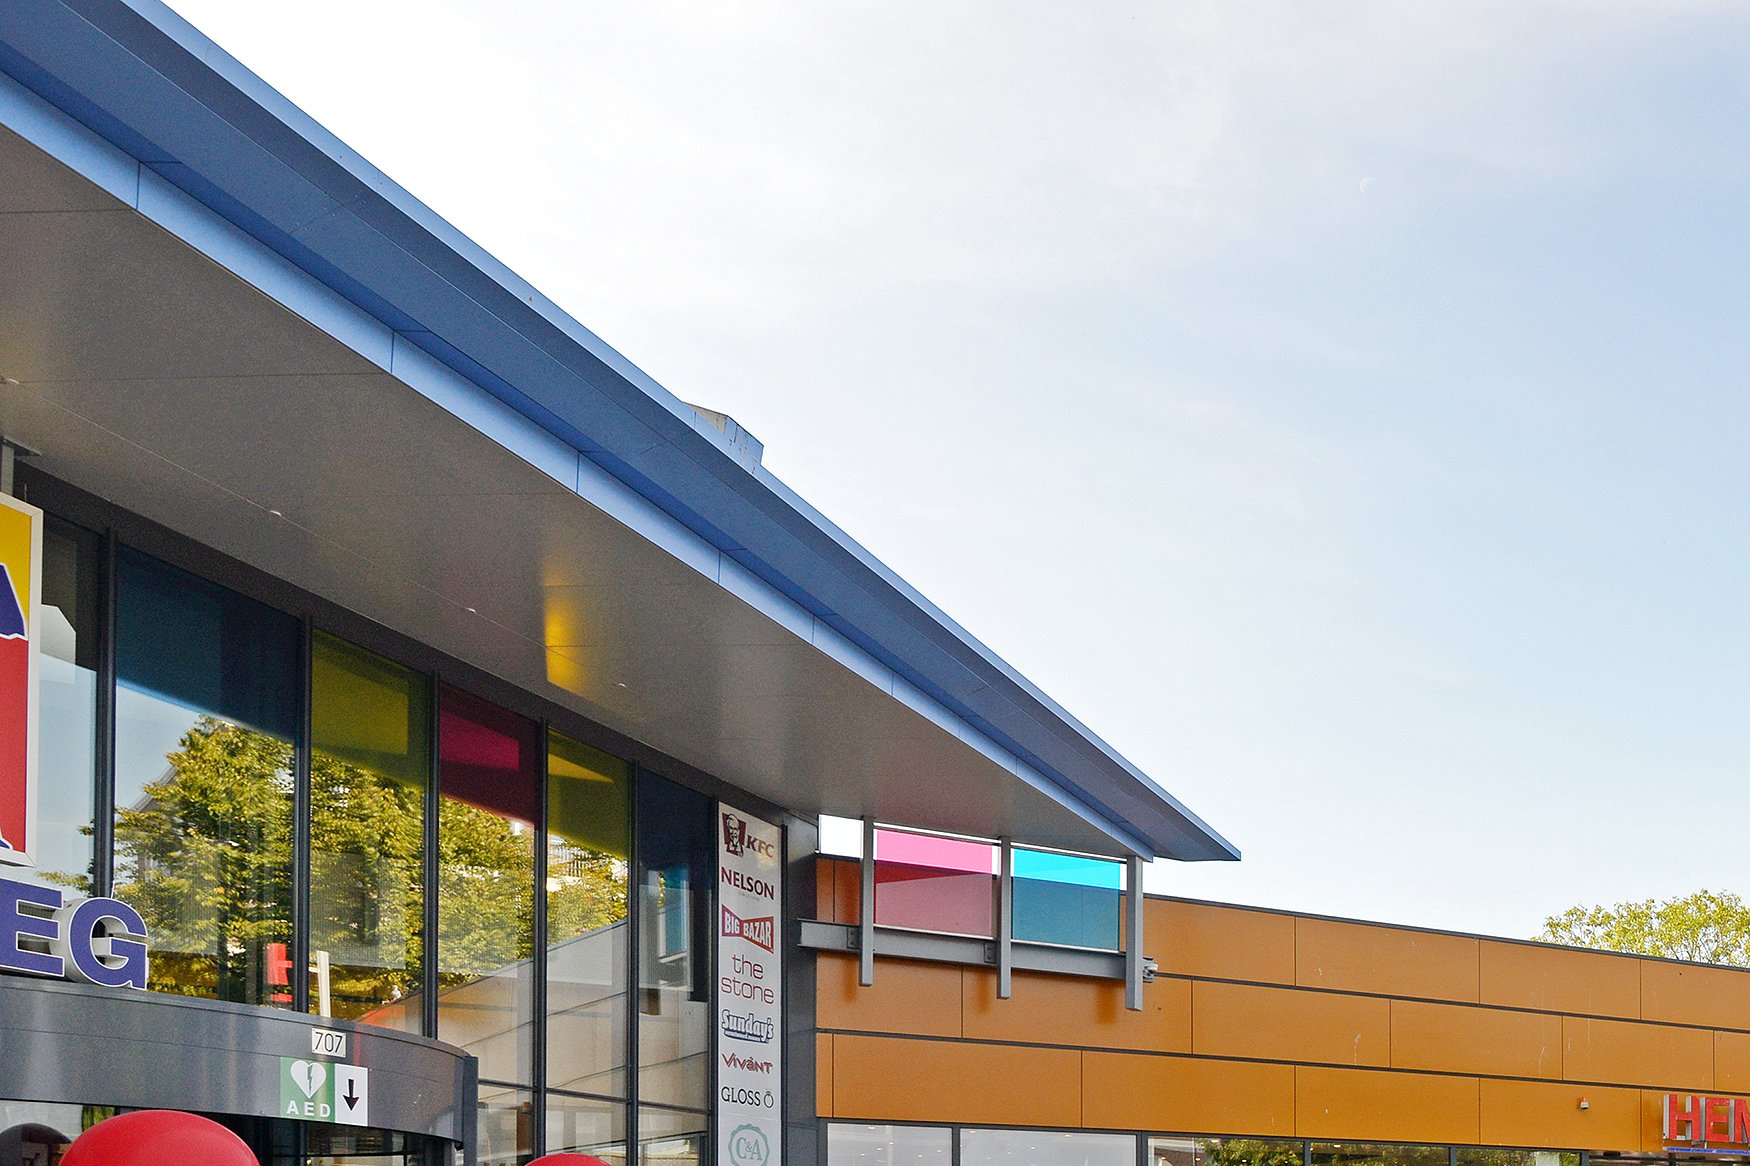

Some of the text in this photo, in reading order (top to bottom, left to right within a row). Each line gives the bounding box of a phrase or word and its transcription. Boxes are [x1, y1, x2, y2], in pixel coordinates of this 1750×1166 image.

[746, 835, 774, 858] KFC
[721, 866, 774, 900] NELSON
[724, 911, 772, 948] BIG BAZAR
[732, 954, 764, 979] the
[721, 977, 774, 1004] stone
[721, 1009, 774, 1043] Sunday's
[315, 1031, 343, 1053] 707
[286, 1100, 331, 1118] AED
[721, 1086, 761, 1107] GLOSS
[735, 1136, 763, 1161] C&A
